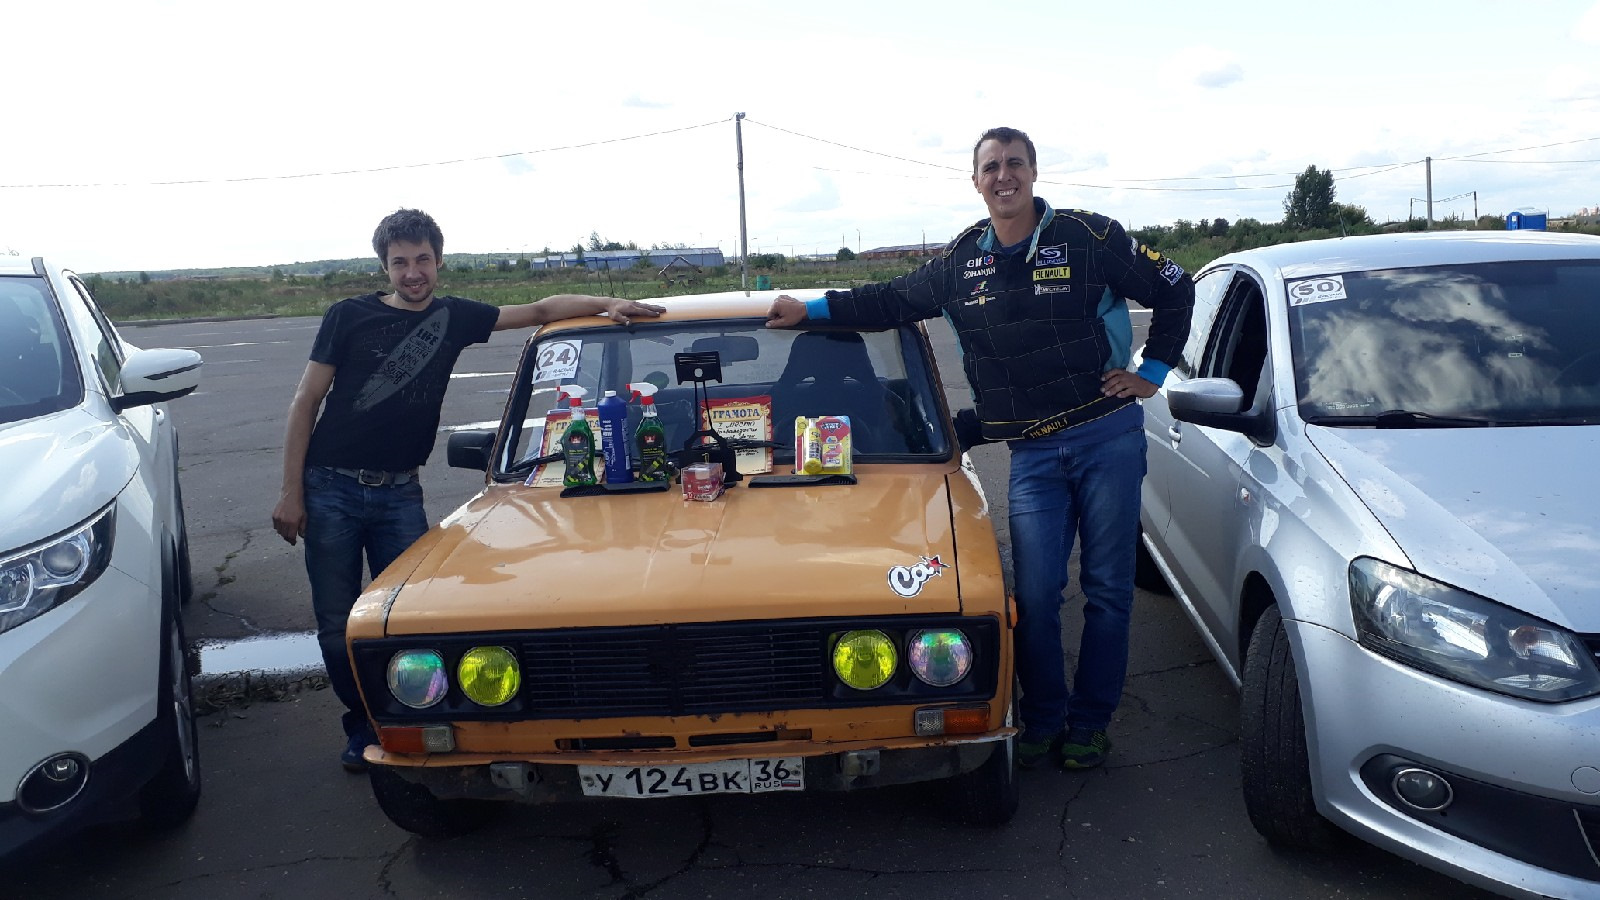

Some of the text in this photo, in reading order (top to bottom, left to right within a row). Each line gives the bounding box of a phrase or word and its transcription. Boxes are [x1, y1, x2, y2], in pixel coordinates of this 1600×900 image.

[966, 256, 983, 268] elf
[1035, 268, 1068, 279] RENAULT
[1298, 281, 1334, 296] 50
[541, 348, 571, 367] 24
[712, 408, 760, 419] ГРАМОТА
[1029, 417, 1069, 439] RENAULT
[755, 759, 792, 782] 36
[754, 780, 781, 789] RUS
